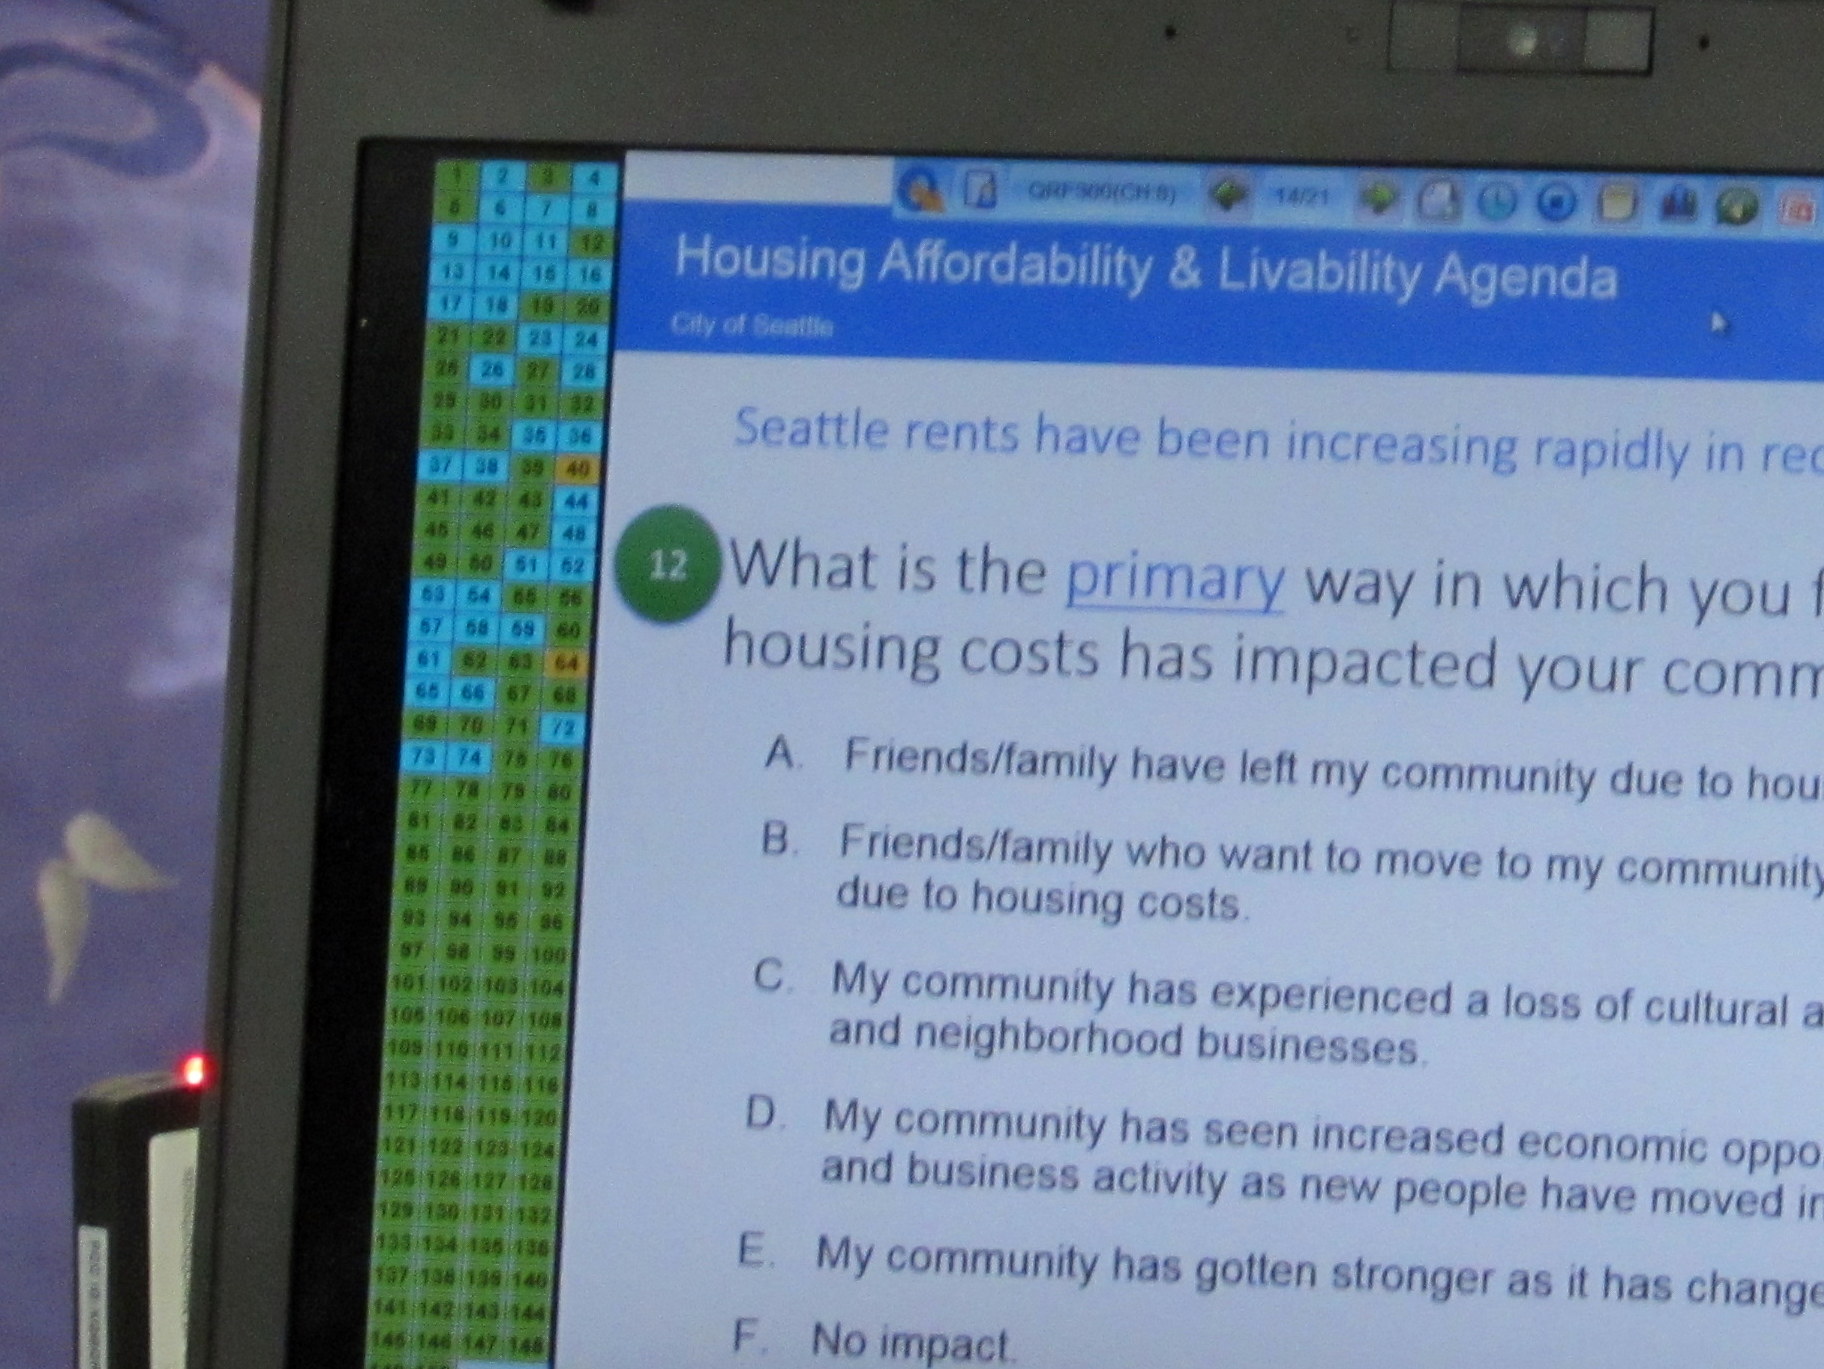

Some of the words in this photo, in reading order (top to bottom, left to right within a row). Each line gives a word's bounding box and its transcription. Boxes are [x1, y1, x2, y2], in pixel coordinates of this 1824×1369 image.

[677, 233, 865, 292] Housing
[878, 238, 1154, 299] Affordability
[1169, 244, 1202, 289] &
[1220, 246, 1423, 306] Livability
[1433, 251, 1617, 308] Agenda
[671, 312, 716, 339] City
[723, 313, 747, 335] of
[753, 313, 834, 338] Seattle
[736, 406, 889, 449] Seattle
[906, 416, 1019, 453] rents
[1036, 411, 1141, 456] have
[1158, 416, 1269, 459] been
[1288, 420, 1518, 477] increasing
[1536, 427, 1690, 480] rapidly
[1707, 431, 1744, 471] in
[651, 549, 688, 580] 12
[730, 537, 877, 590] What
[899, 543, 936, 592] is
[958, 543, 1046, 594] the
[1065, 550, 1285, 616] primary
[1306, 568, 1415, 619] way
[1435, 559, 1480, 608] in
[1504, 558, 1667, 613] which
[1690, 579, 1790, 627] you
[725, 614, 940, 685] housing
[961, 631, 1098, 676] costs
[1122, 626, 1212, 680] has
[1235, 633, 1496, 696] impacted
[1518, 655, 1644, 703] your
[846, 736, 1117, 788] Friends/family
[1132, 747, 1225, 782] have
[1241, 750, 1296, 784] left
[1312, 760, 1368, 796] my
[1382, 761, 1596, 803] community
[1610, 762, 1683, 797] due
[1698, 765, 1733, 798] to
[841, 823, 1113, 875] Friends/family
[1126, 834, 1206, 869] who
[1220, 840, 1312, 872] want
[1327, 841, 1361, 874] to
[1376, 849, 1482, 877] move
[1498, 846, 1531, 879] to
[1547, 855, 1604, 891] my
[837, 875, 908, 909] due
[924, 878, 957, 911] to
[972, 879, 1123, 927] housing
[1138, 887, 1249, 922] costs.
[833, 960, 889, 1004] My
[903, 970, 1114, 1013] community
[1129, 971, 1197, 1006] has
[1211, 979, 1452, 1018] experienced
[1467, 991, 1488, 1016] a
[1504, 984, 1581, 1020] loss
[1596, 988, 1634, 1021] of
[1645, 991, 1788, 1027] cultural
[830, 1014, 900, 1047] and
[916, 1017, 1183, 1060] neighborhood
[1198, 1025, 1427, 1066] businesses.
[825, 1098, 881, 1142] My
[895, 1108, 1106, 1150] community
[1121, 1109, 1189, 1144] has
[1205, 1119, 1297, 1148] seen
[1313, 1119, 1504, 1156] increased
[1518, 1128, 1707, 1164] economic
[822, 1151, 893, 1184] and
[908, 1154, 1079, 1191] business
[1093, 1162, 1227, 1206] activity
[1241, 1172, 1285, 1199] as
[1301, 1174, 1381, 1202] new
[1394, 1174, 1526, 1216] people
[1542, 1176, 1636, 1212] have
[1651, 1184, 1783, 1218] moved
[817, 1235, 873, 1279] My
[887, 1245, 1098, 1289] community
[1113, 1247, 1182, 1283] has
[1196, 1253, 1316, 1294] gotten
[1333, 1257, 1494, 1303] stronger
[1508, 1270, 1552, 1297] as
[1569, 1266, 1587, 1298] it
[1603, 1266, 1672, 1302] has
[812, 1322, 867, 1358] No
[881, 1326, 1017, 1369] impact.
